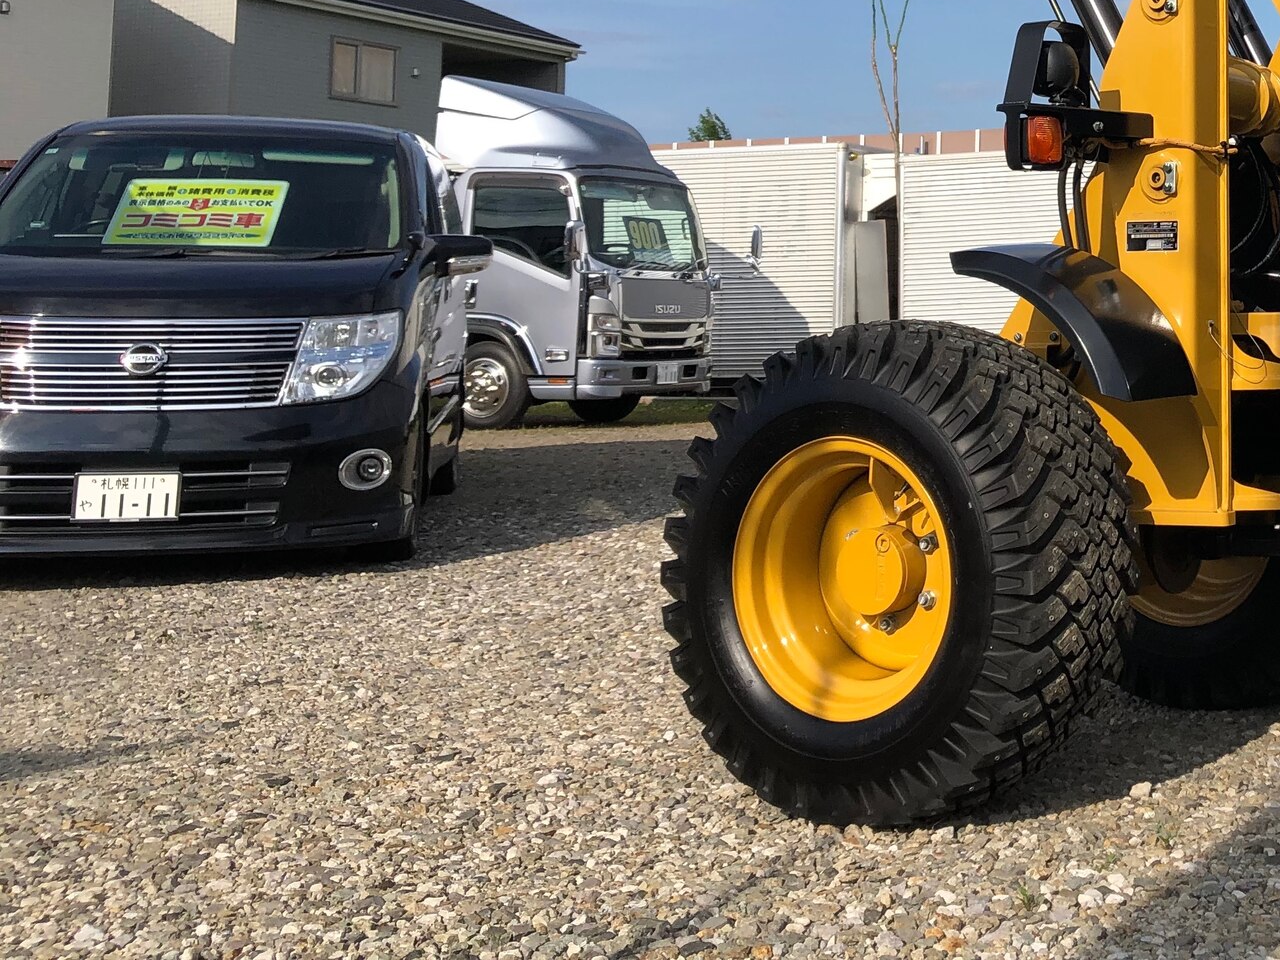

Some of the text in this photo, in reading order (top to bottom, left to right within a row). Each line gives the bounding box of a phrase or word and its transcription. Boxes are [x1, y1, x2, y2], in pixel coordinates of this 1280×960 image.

[121, 212, 265, 229] コミコミ車
[628, 220, 661, 250] 900
[655, 304, 681, 314] ISUZU
[101, 477, 156, 490] 札幌 111
[79, 493, 170, 518] や 11-11
